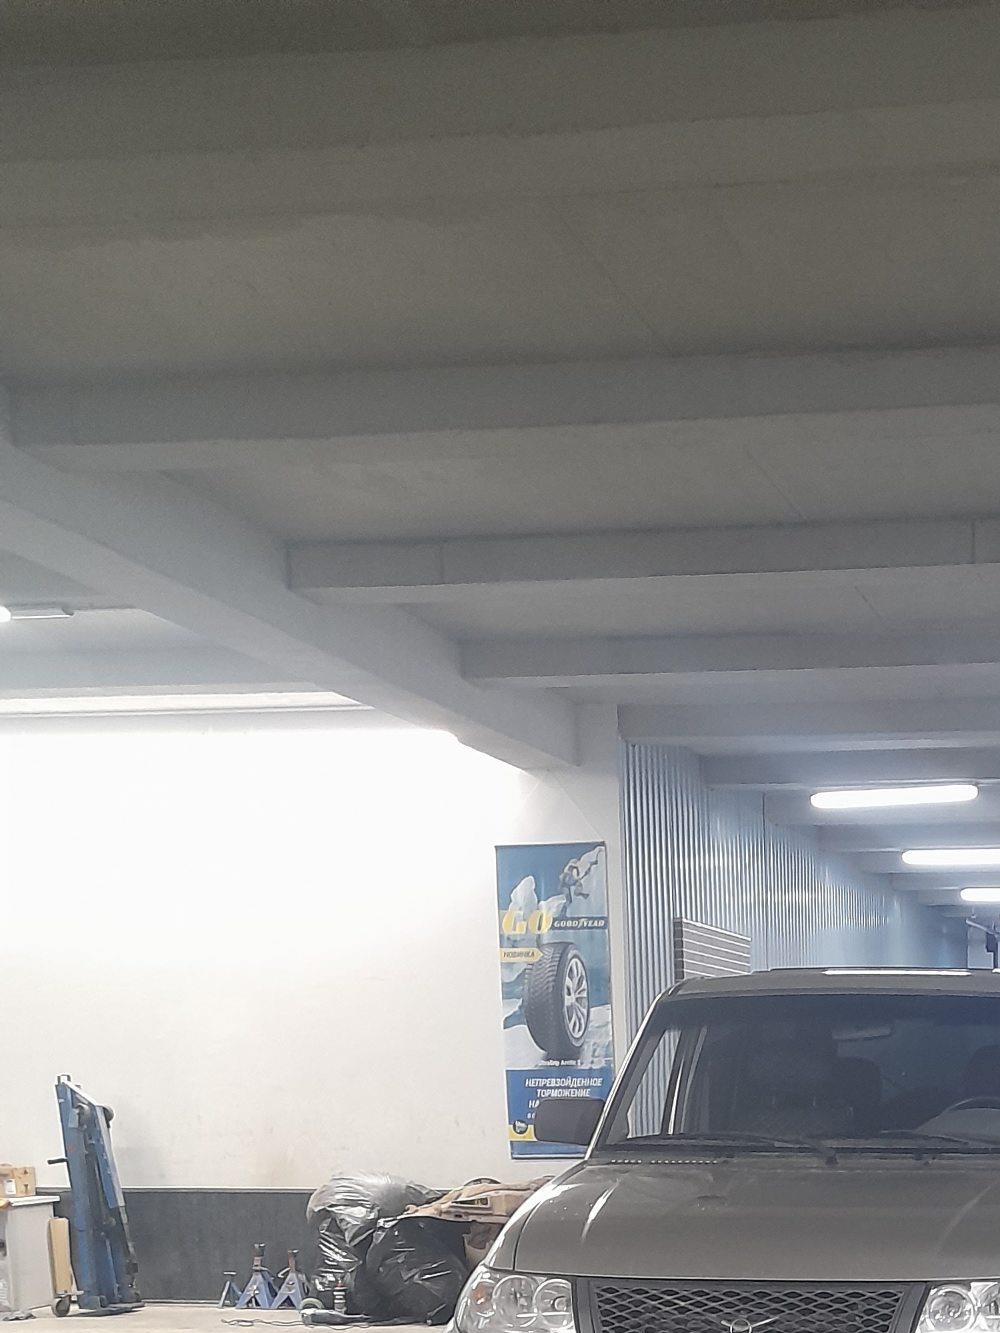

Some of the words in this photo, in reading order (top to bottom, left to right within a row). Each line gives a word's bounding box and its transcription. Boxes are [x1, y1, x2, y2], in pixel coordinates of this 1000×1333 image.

[502, 910, 553, 934] GO
[525, 1076, 603, 1088] НЕПРЕВЗОЙДЕННОЕ
[537, 1089, 591, 1098] ТОРМОЖЕНИЕ
